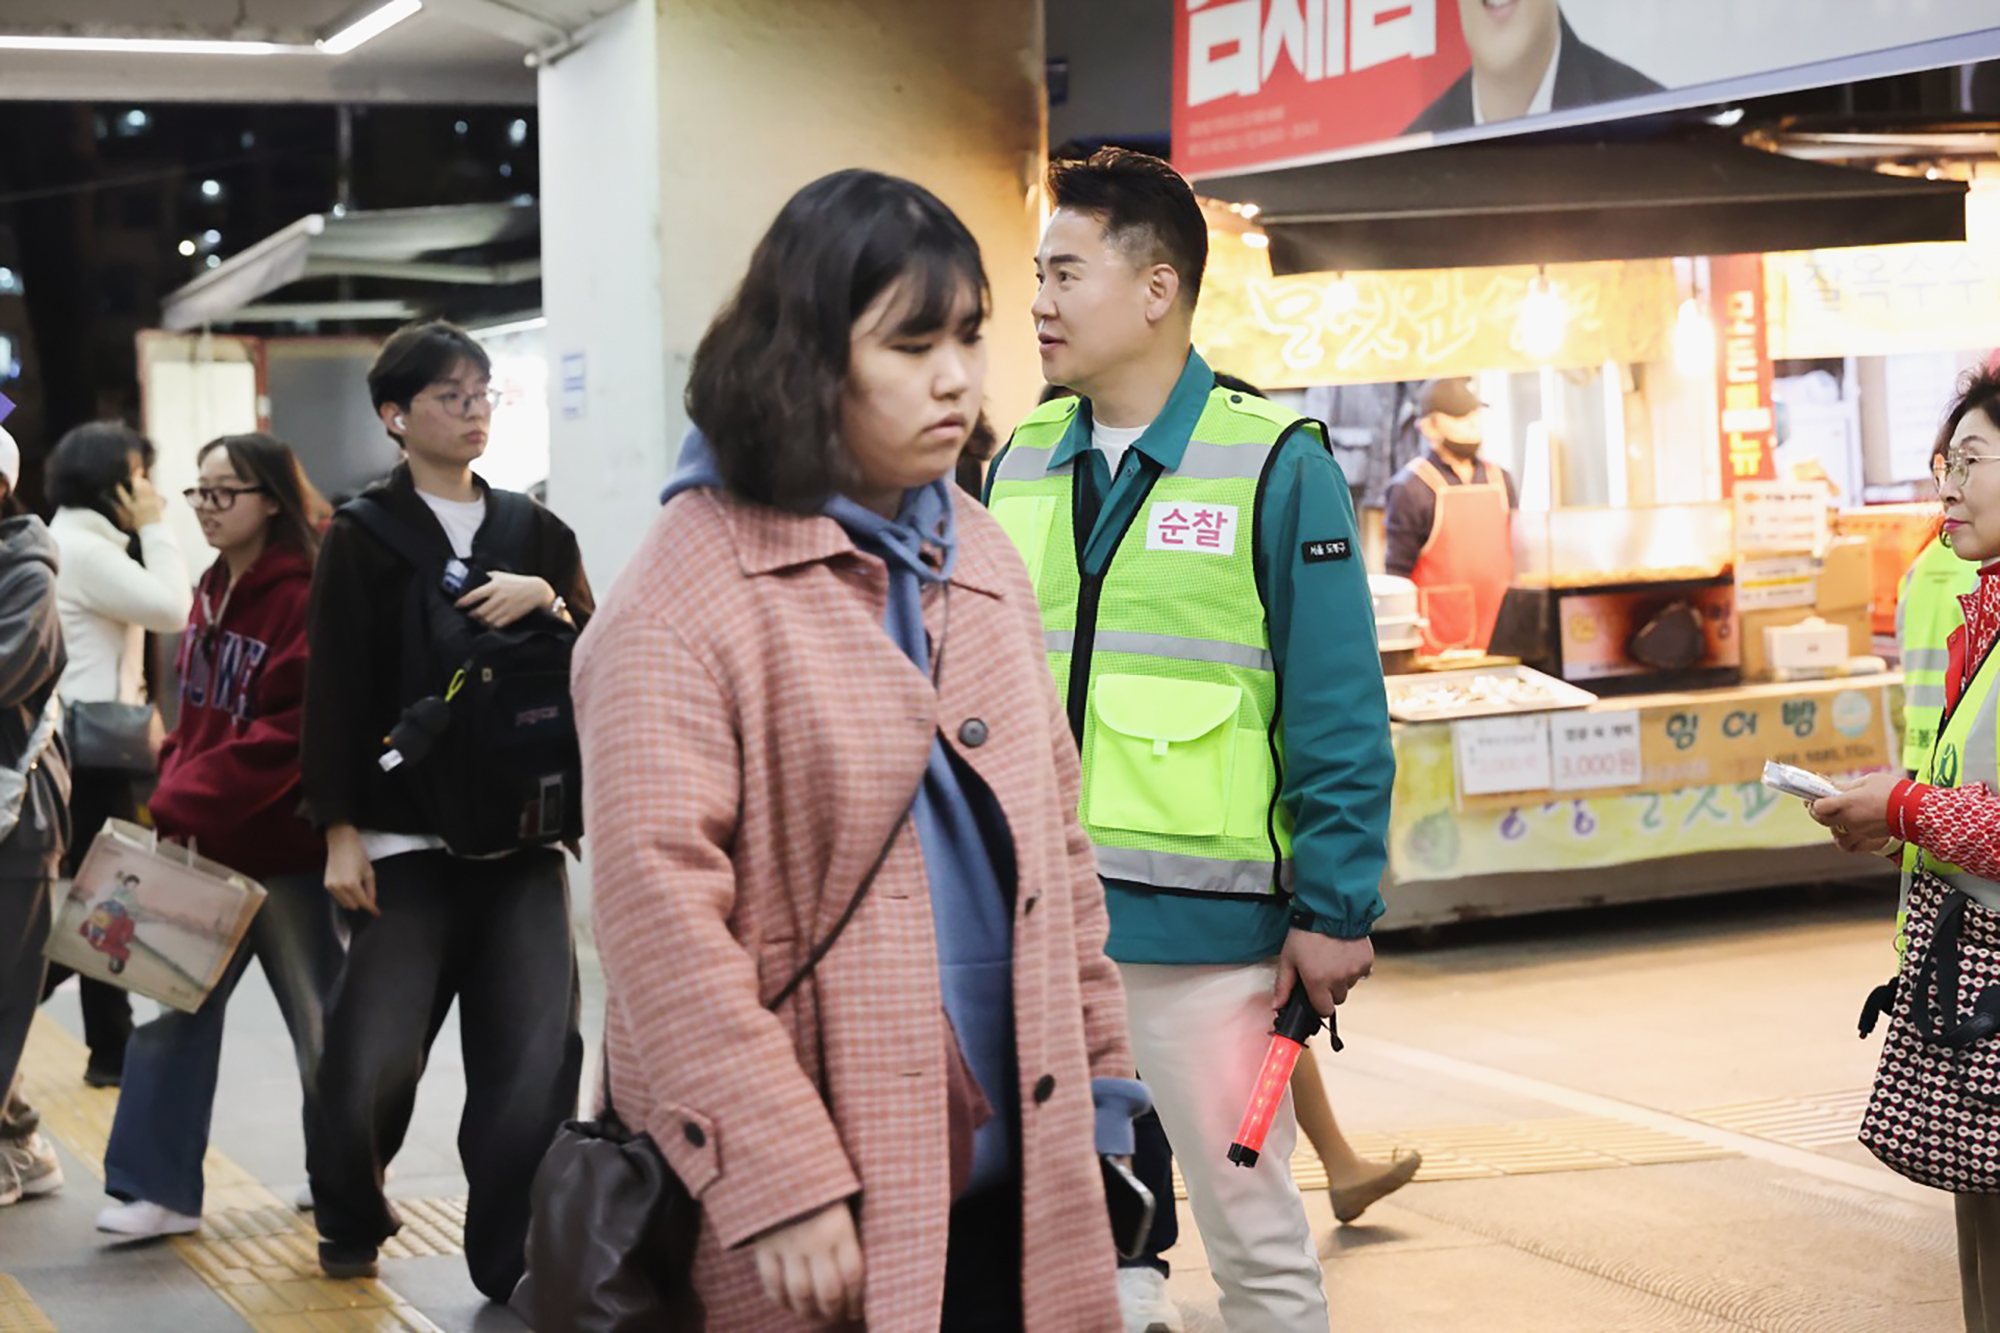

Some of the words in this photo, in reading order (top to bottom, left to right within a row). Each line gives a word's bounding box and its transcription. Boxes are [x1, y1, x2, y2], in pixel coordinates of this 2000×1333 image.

[1158, 509, 1228, 547] 순찰
[1310, 543, 1325, 556] 서울
[1326, 541, 1346, 554] 도봉구
